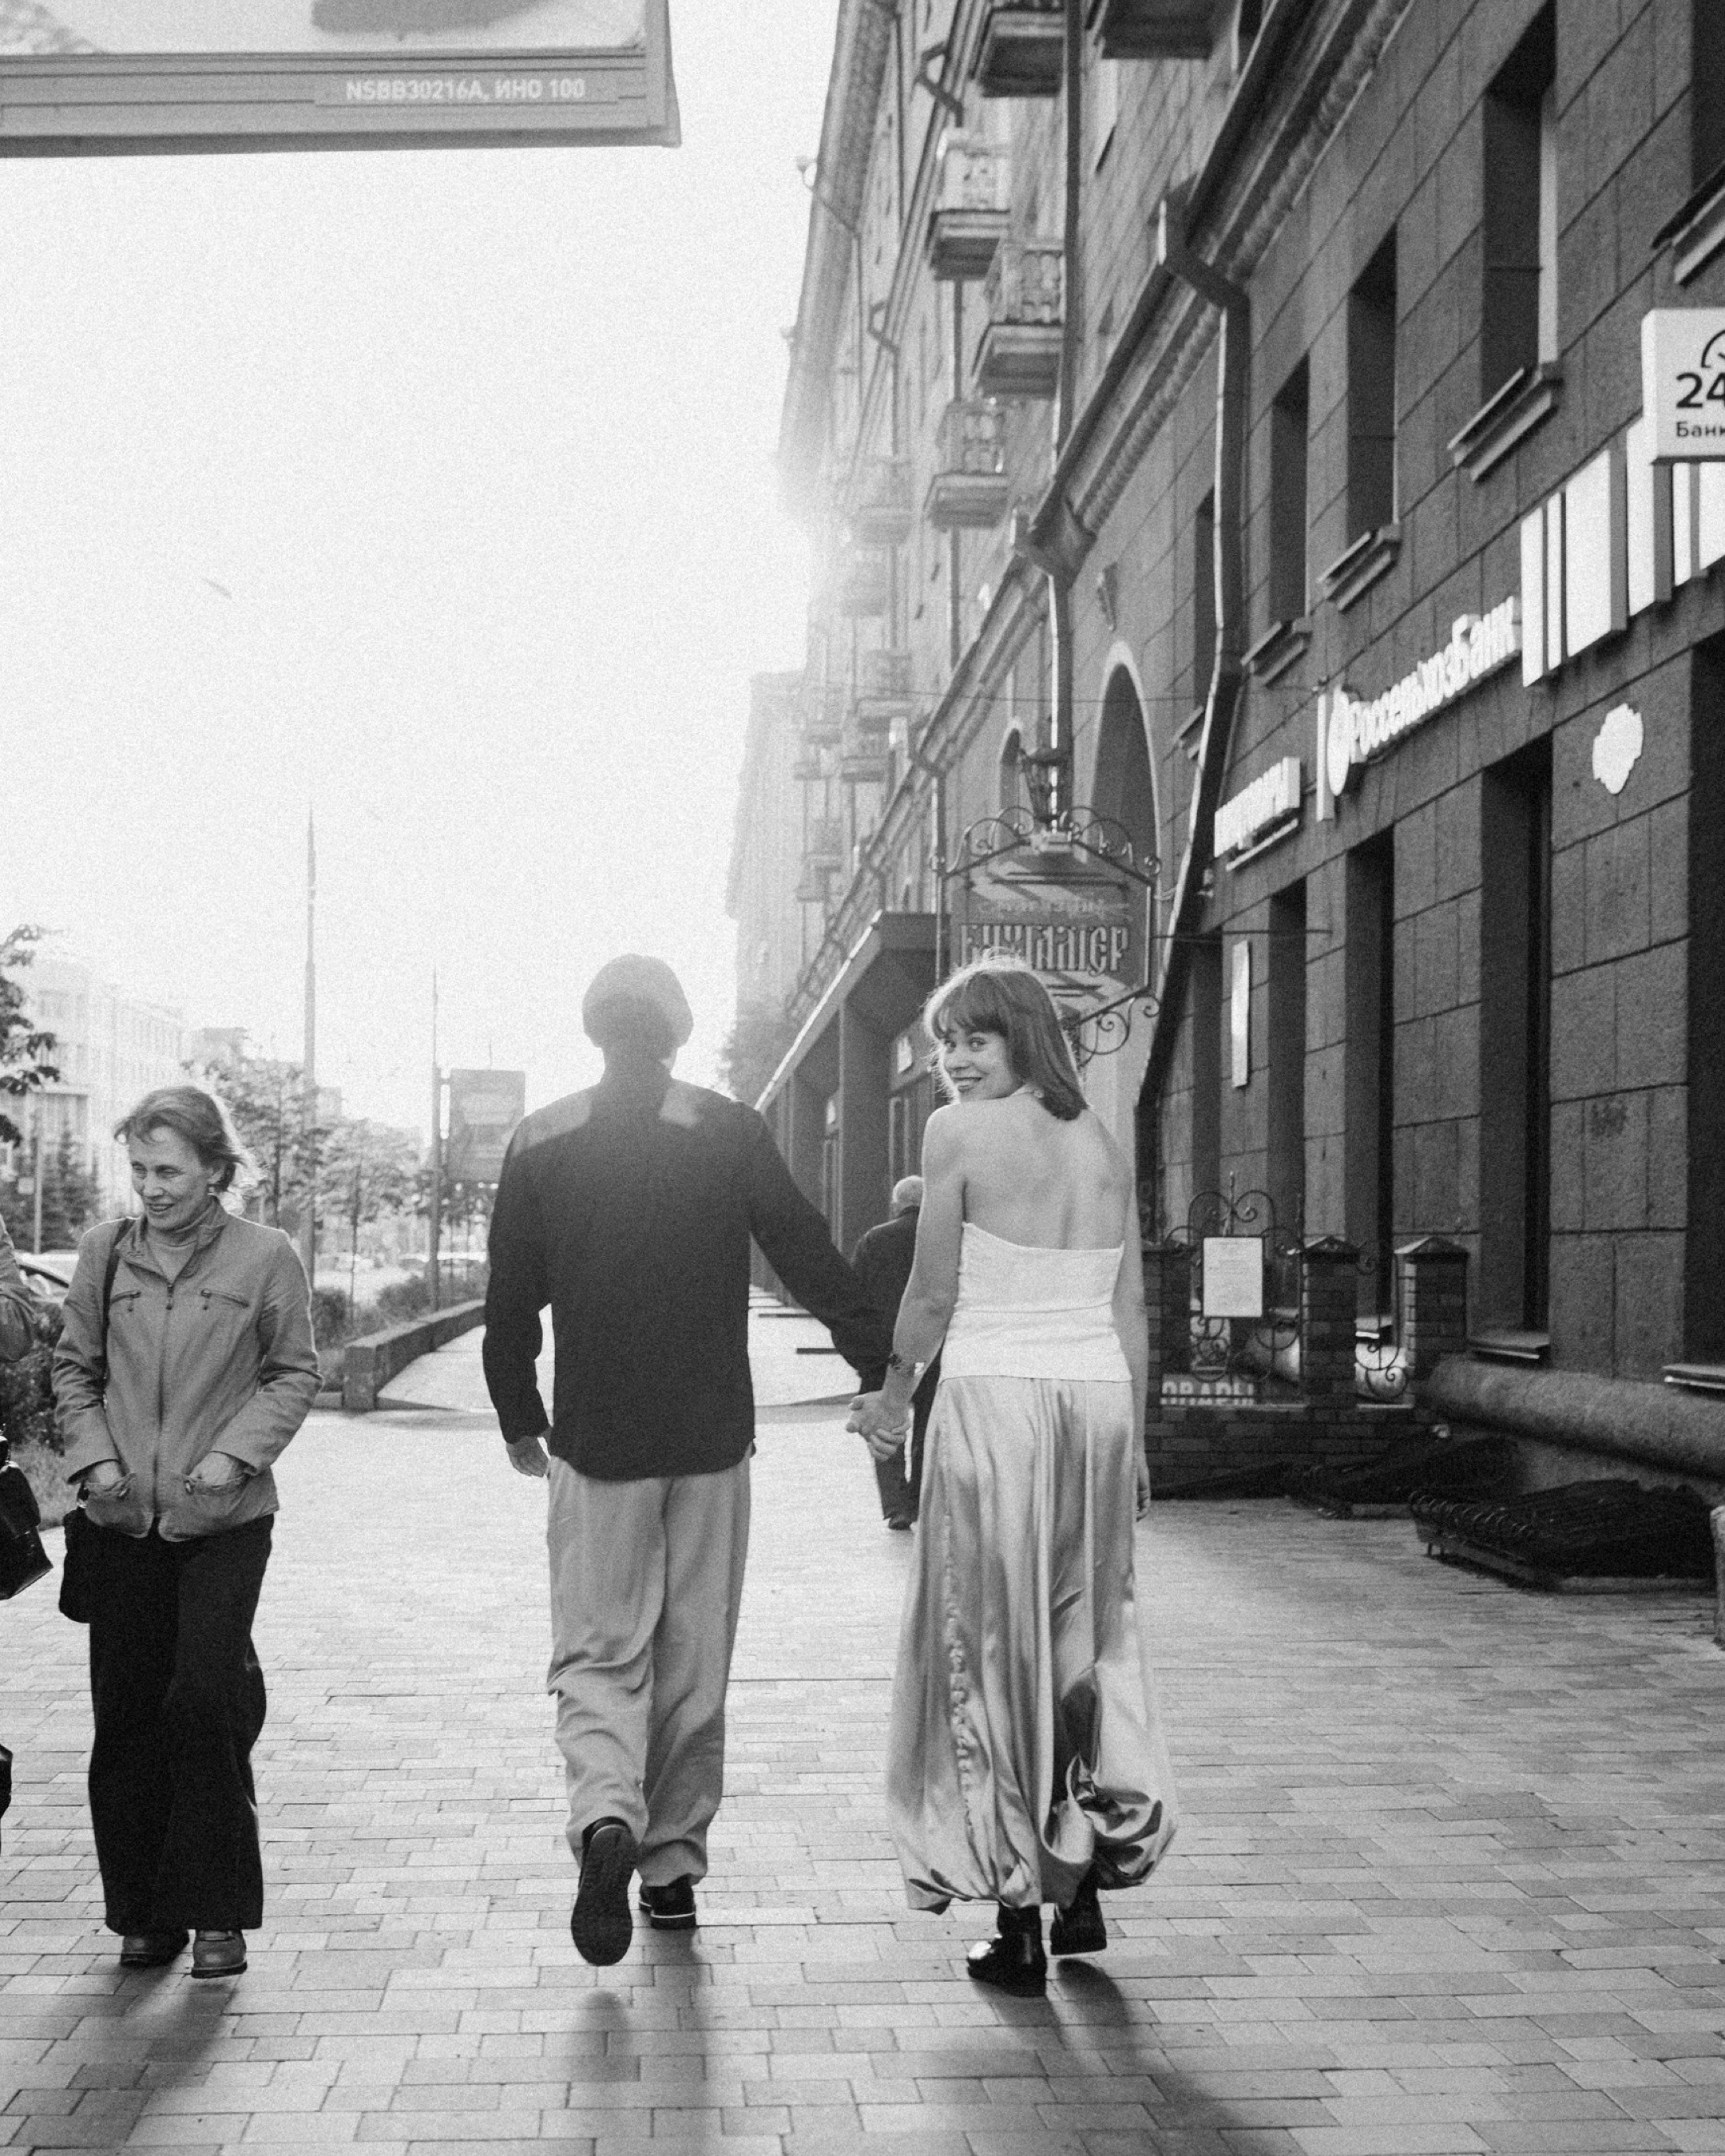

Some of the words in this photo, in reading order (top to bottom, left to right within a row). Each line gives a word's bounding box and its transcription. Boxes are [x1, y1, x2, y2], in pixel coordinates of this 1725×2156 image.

[494, 78, 543, 100] ИНО
[549, 77, 586, 99] 100
[1675, 372, 1725, 409] 24
